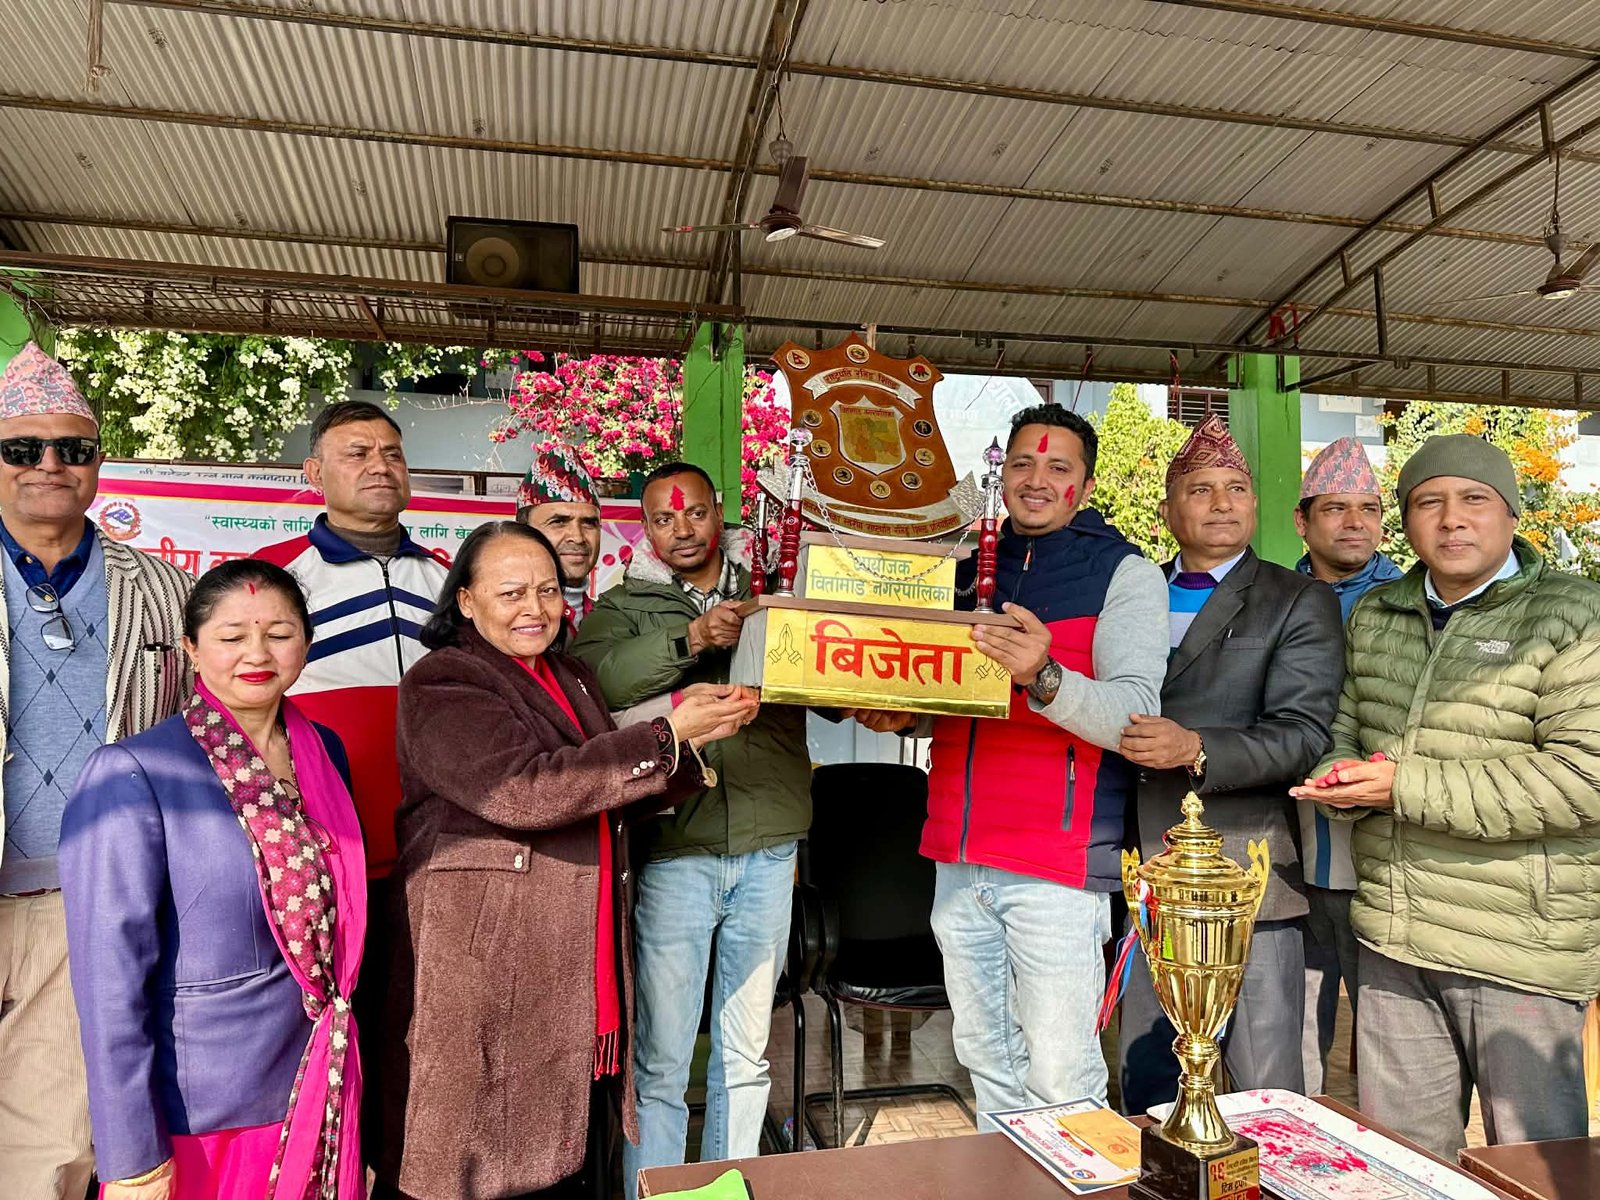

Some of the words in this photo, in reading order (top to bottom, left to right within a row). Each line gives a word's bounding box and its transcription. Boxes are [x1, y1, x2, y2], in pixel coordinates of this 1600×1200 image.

[282, 516, 313, 533] लागि
[419, 523, 449, 539] लागि
[872, 578, 952, 603] नगरपालिका
[809, 619, 972, 686] बिजेता
